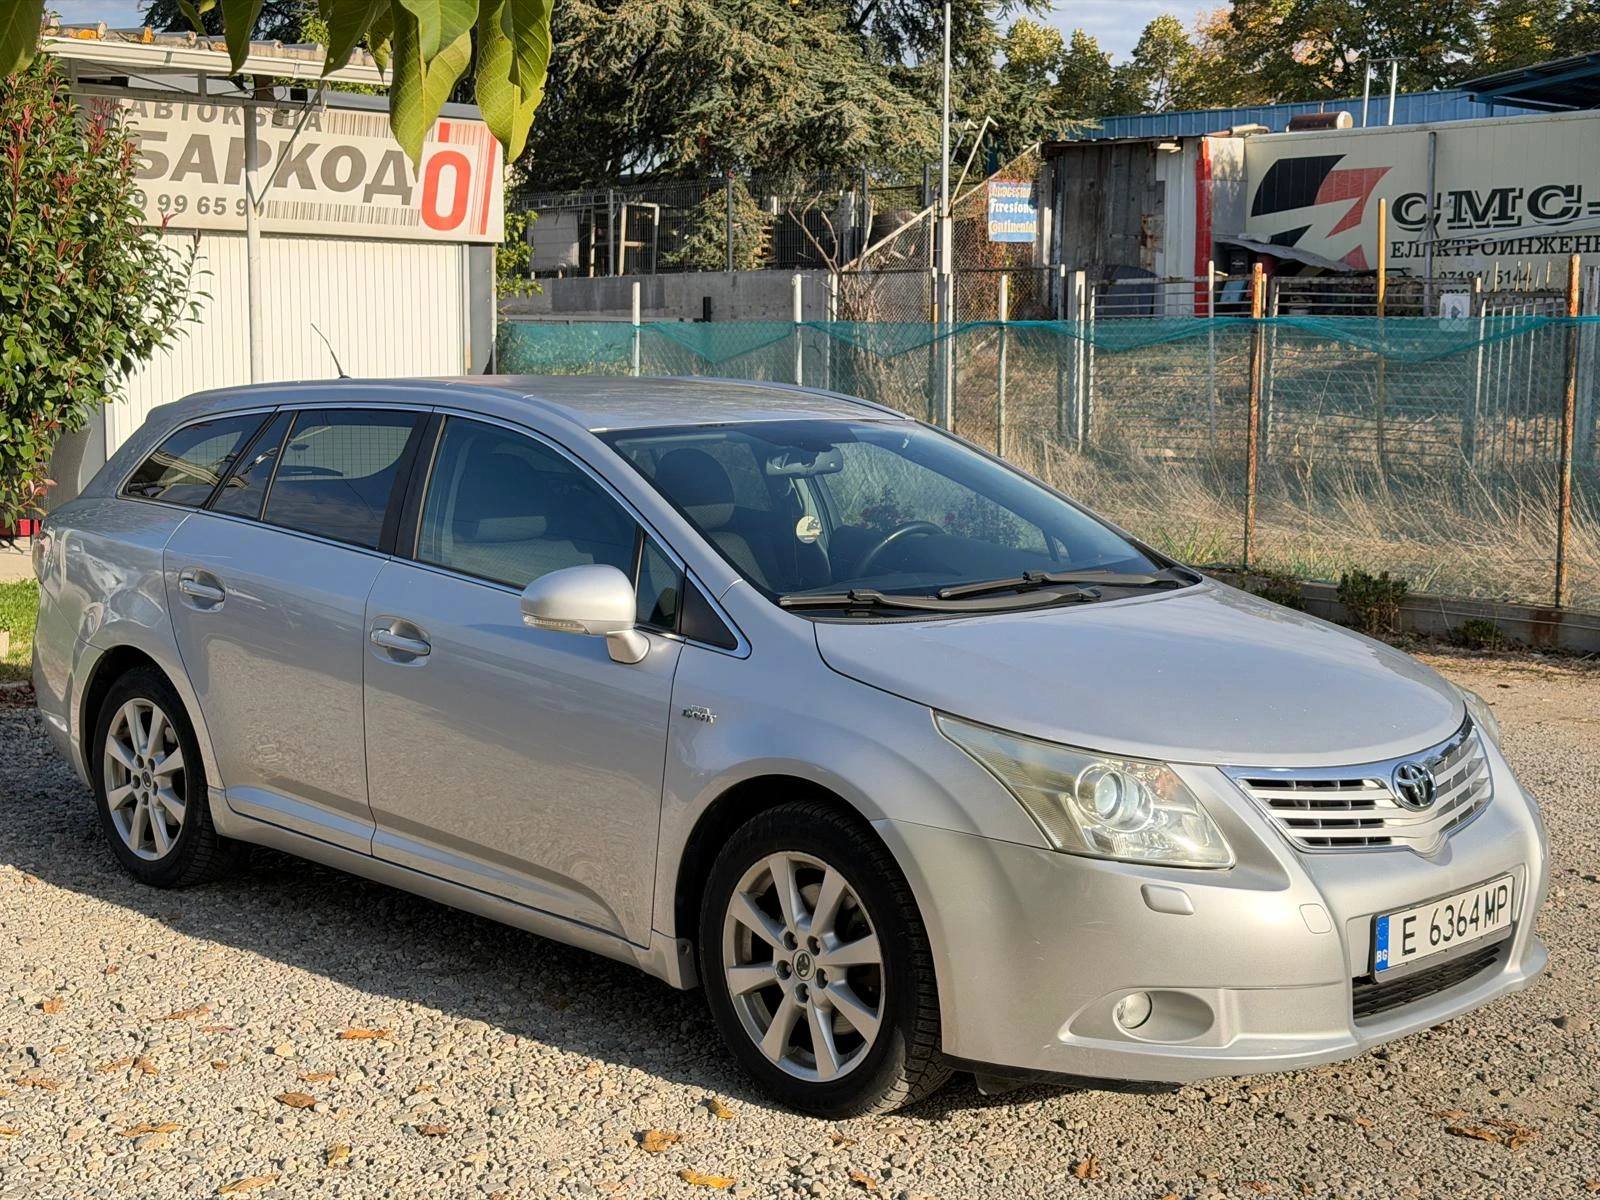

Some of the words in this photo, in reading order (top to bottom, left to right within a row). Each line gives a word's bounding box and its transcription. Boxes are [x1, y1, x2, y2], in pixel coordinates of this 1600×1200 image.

[131, 129, 413, 206] БАРКОД
[157, 193, 188, 214] 99
[196, 195, 227, 216] 65
[1390, 235, 1600, 259] ЕЛКТРОИНЖЕН
[1376, 949, 1388, 963] BG
[1402, 915, 1417, 957] E
[1429, 894, 1480, 946] 6364
[1484, 884, 1508, 929] MP
